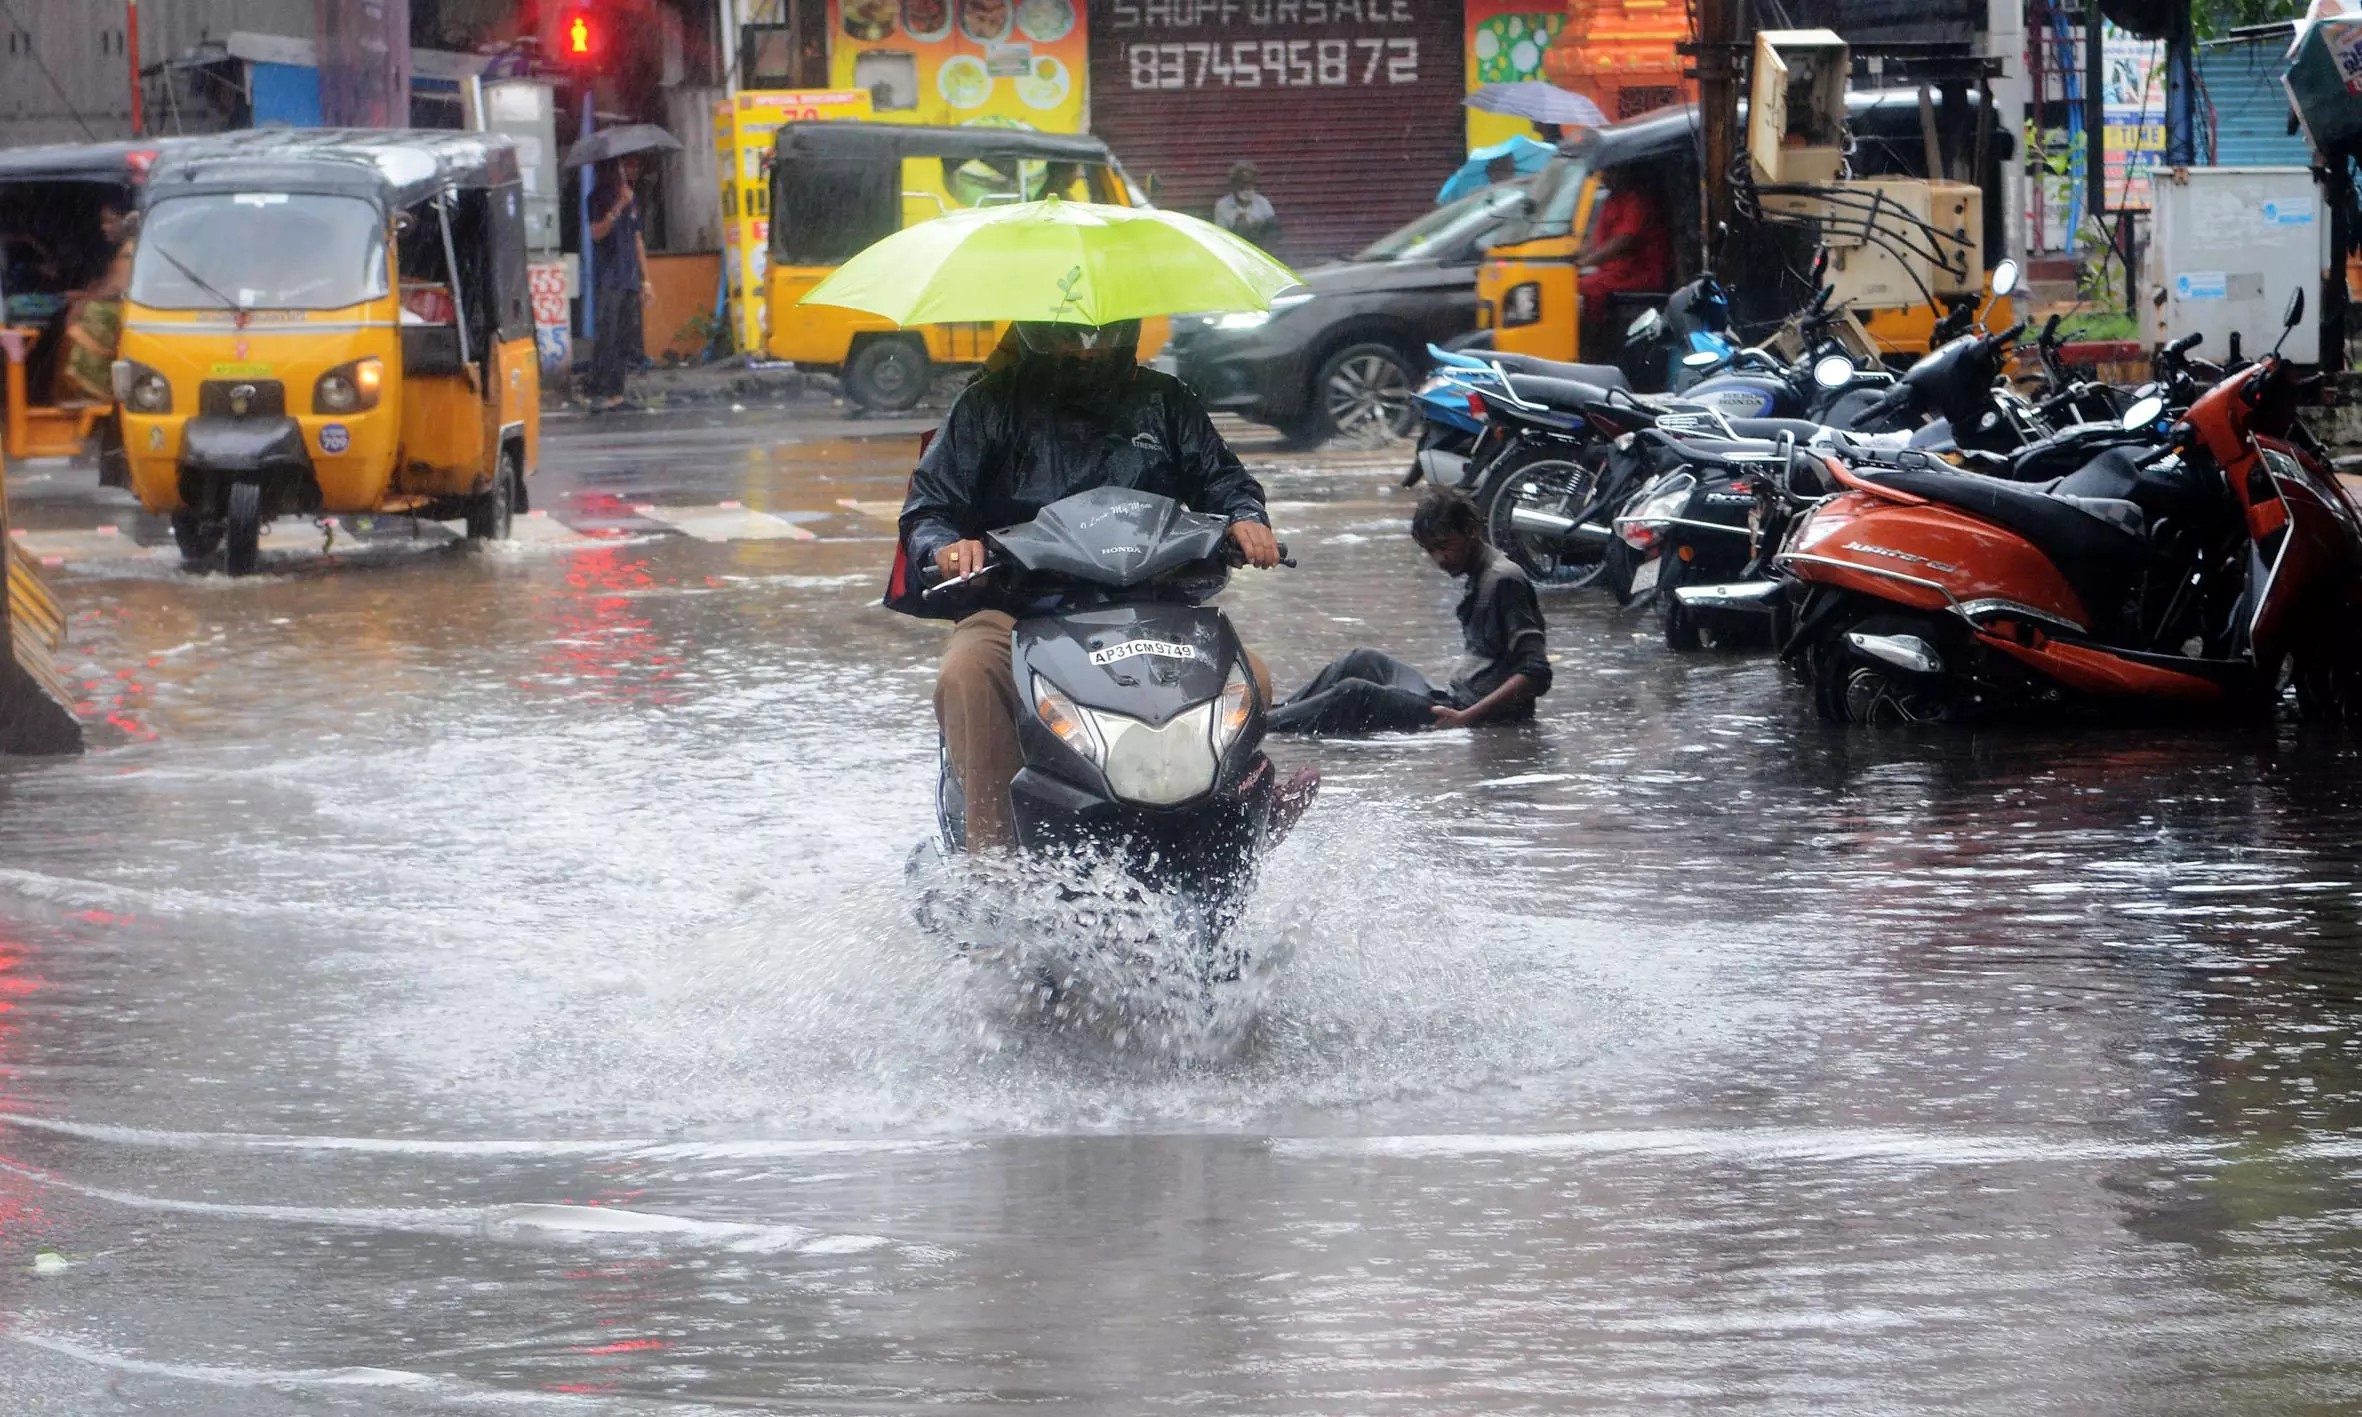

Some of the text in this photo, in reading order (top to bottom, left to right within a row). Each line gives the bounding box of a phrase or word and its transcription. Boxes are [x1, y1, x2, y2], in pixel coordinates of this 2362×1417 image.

[1129, 37, 1419, 90] 8374595872
[1101, 546, 1142, 555] HONDA
[1095, 642, 1192, 662] AP31CM9749
